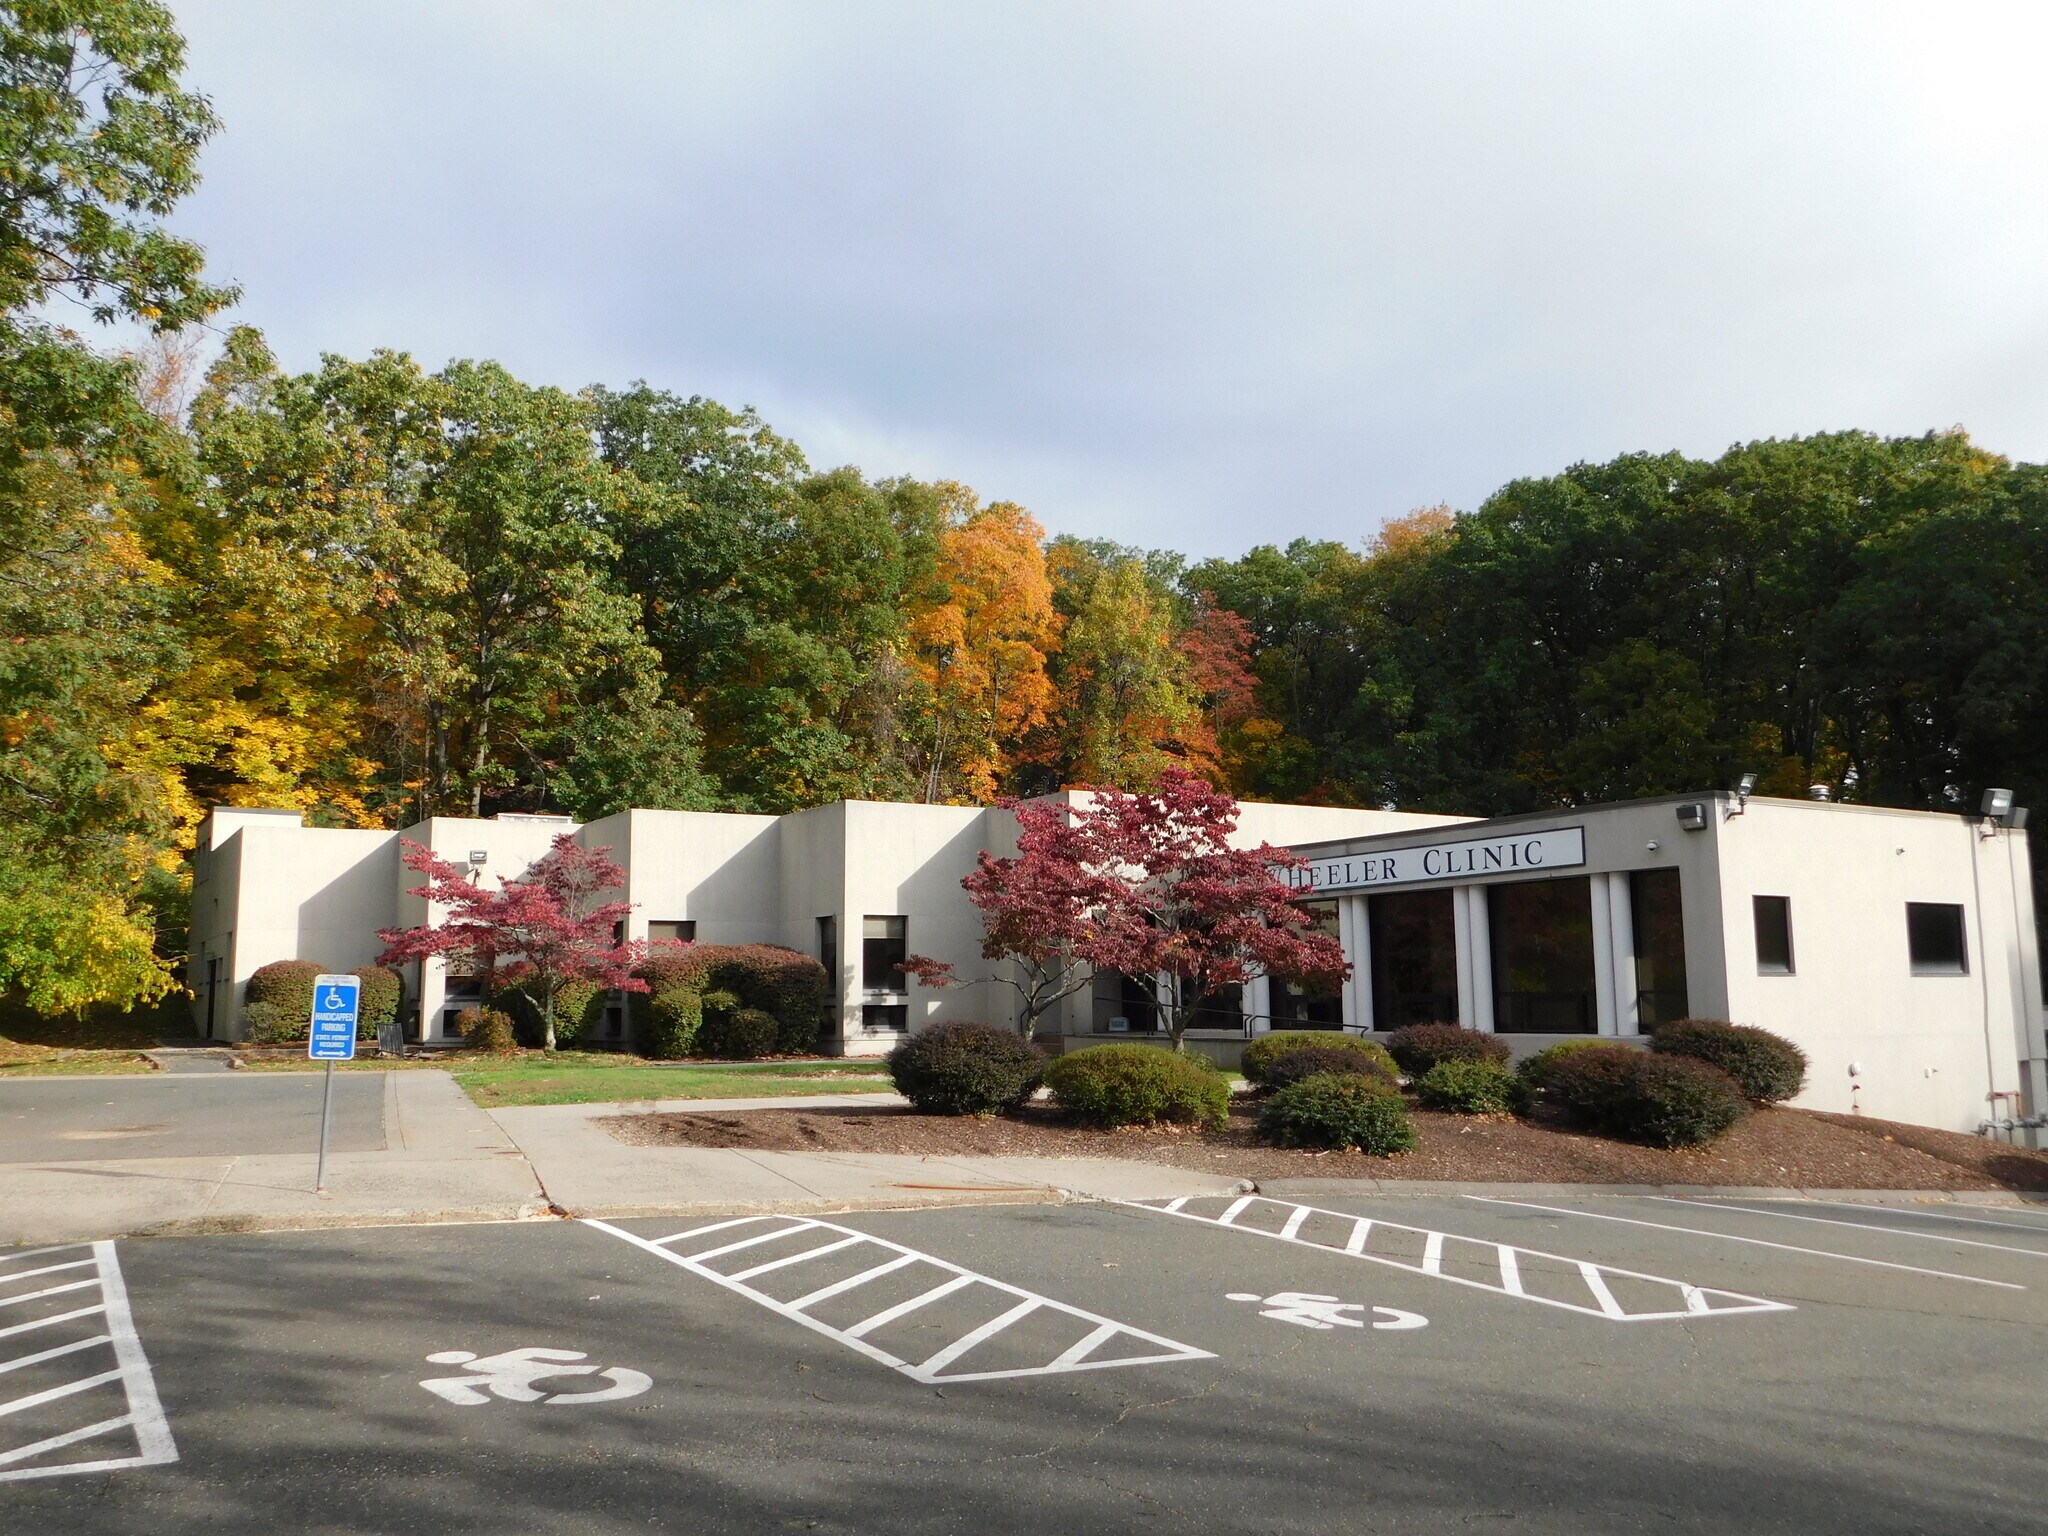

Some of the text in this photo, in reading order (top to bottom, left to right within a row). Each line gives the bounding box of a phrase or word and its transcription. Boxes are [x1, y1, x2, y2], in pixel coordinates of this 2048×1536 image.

[1423, 840, 1543, 875] CLINIC
[315, 1012, 353, 1021] HANDICAPPED
[321, 1023, 346, 1031] PARKING
